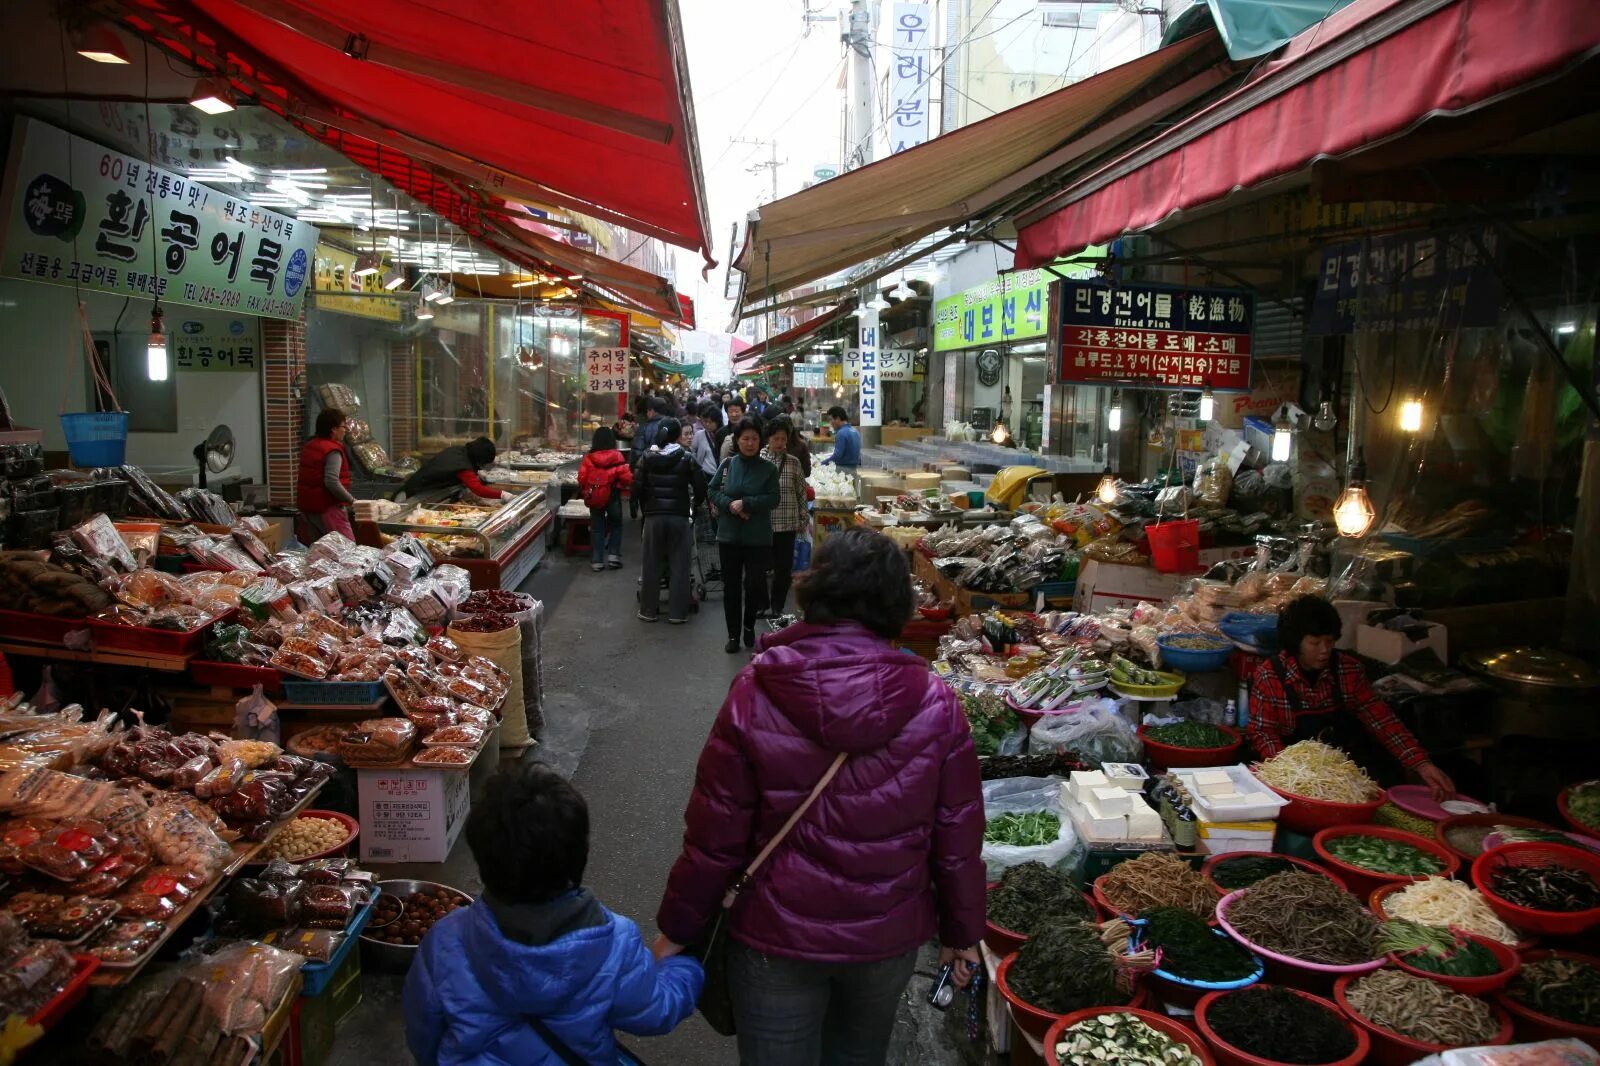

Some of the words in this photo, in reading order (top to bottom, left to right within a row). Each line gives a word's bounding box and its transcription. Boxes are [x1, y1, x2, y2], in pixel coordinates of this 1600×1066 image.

[99, 153, 140, 188] 60년
[145, 167, 184, 202] 전통의
[188, 183, 210, 210] 맛!
[223, 199, 294, 240] 원조부산어묵
[53, 200, 74, 225] 모루
[95, 189, 283, 296] 환공어묵
[20, 252, 63, 279] 선물용
[126, 271, 168, 297] 택배전문
[183, 283, 196, 300] TEL
[199, 287, 241, 308] 245-2969
[246, 295, 260, 310] FAX
[1075, 288, 1172, 318] 민경건어물
[1189, 295, 1246, 323] 乾漁物
[964, 291, 1042, 342] 대보선식
[1115, 317, 1144, 329] Dried
[1148, 319, 1171, 330] Fish
[1077, 329, 1159, 350] 각종건어물
[177, 346, 254, 368] 환공어묵
[588, 350, 626, 362] 추어탕
[845, 351, 912, 369] 우분식
[1216, 358, 1241, 375] 전문
[588, 363, 626, 375] 선지국
[860, 326, 875, 419] 대보선식
[588, 378, 627, 391] 감자탕
